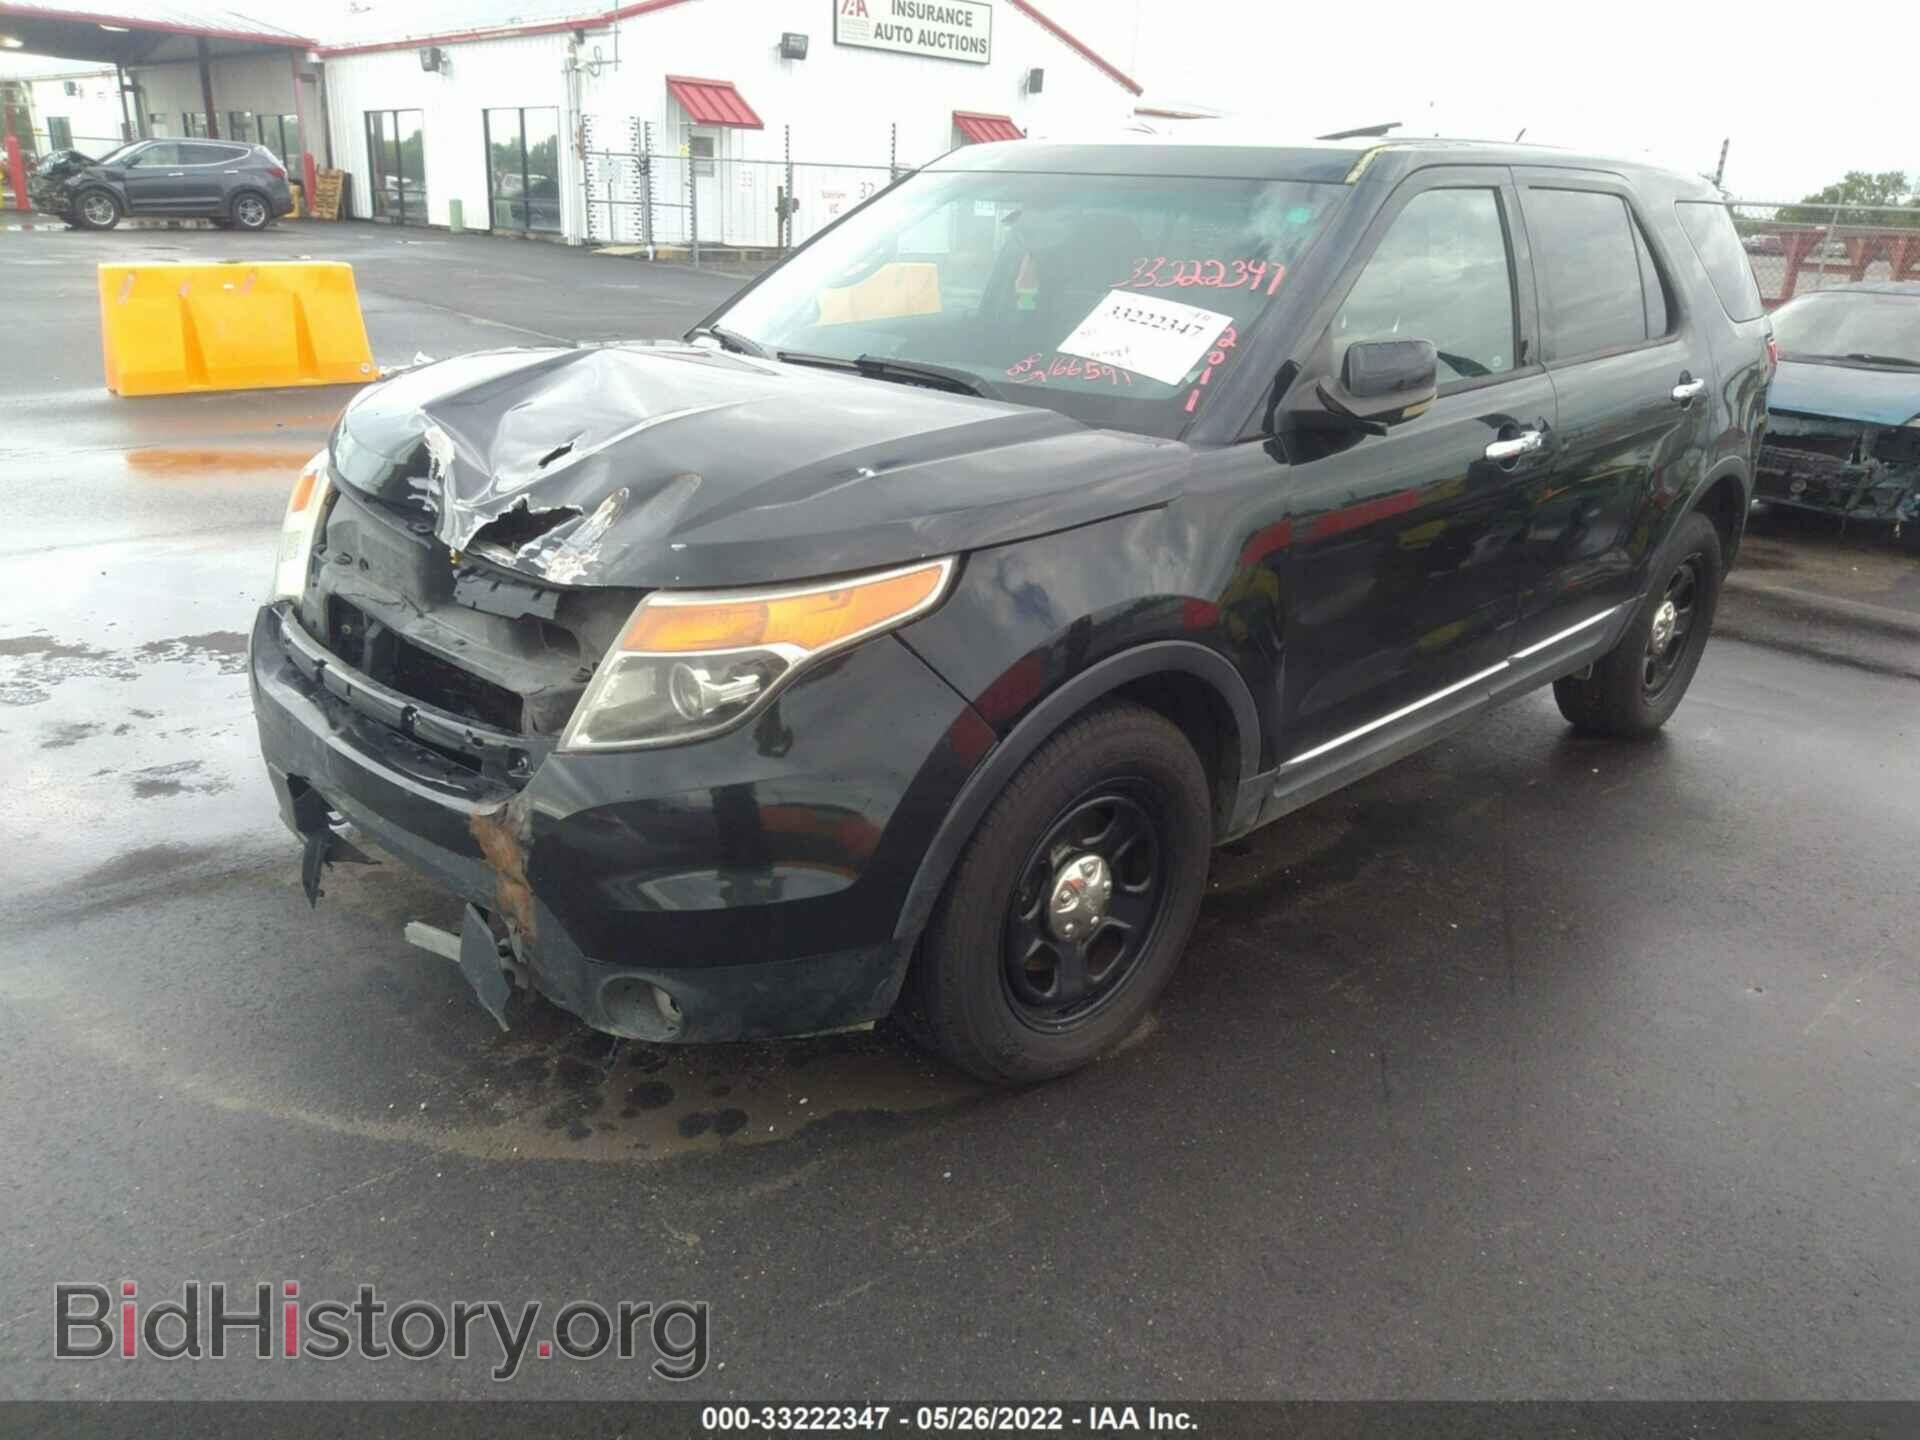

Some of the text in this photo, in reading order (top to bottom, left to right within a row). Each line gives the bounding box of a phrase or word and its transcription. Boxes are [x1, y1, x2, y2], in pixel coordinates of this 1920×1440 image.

[891, 0, 973, 28] INSURANCE
[873, 22, 914, 44] AUTO
[917, 28, 988, 54] AUCTIONS
[1109, 256, 1286, 296] 33222347
